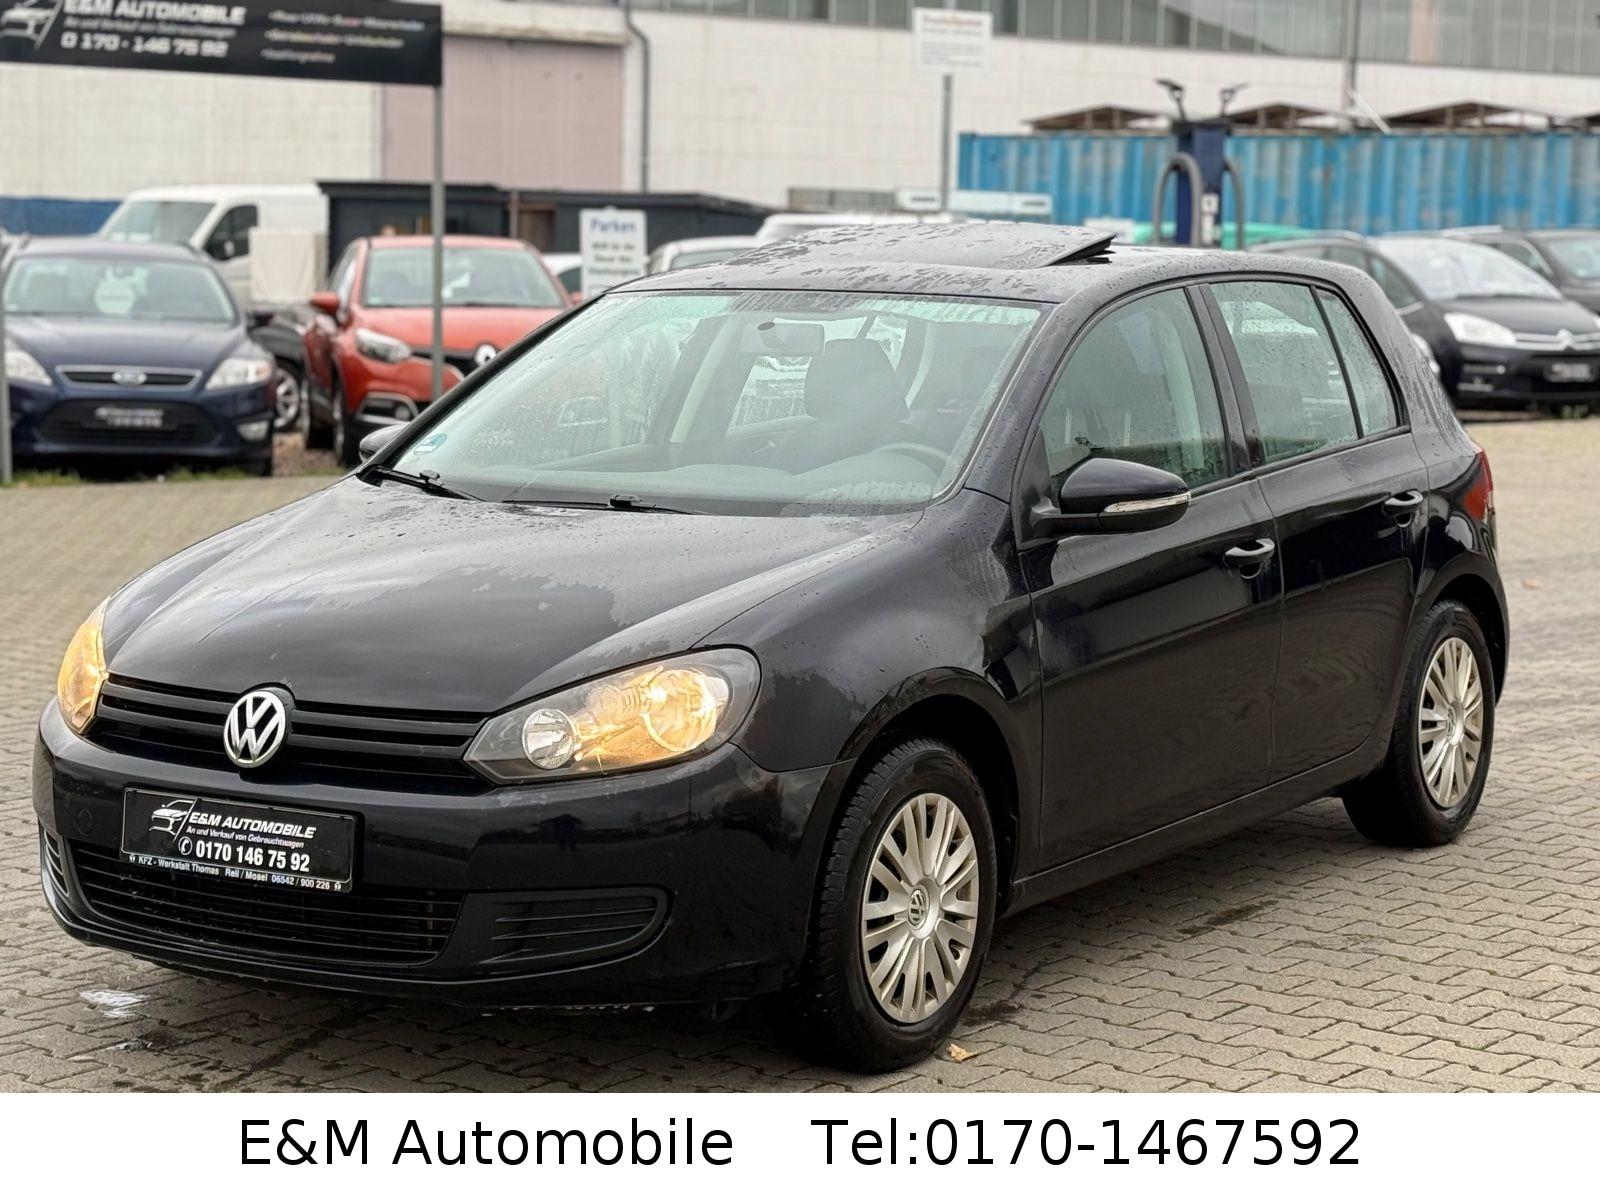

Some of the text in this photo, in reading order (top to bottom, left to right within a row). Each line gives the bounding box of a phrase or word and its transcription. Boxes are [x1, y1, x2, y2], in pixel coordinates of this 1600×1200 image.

[114, 0, 247, 26] AUTOMOBILE
[188, 811, 317, 839] E&M AUTOMOBILE
[138, 855, 153, 866] KFZ
[158, 858, 190, 872] Werkstatt
[191, 863, 220, 876] Thomas
[245, 870, 268, 882] Mosel
[196, 840, 310, 873] 0170 146 75 92
